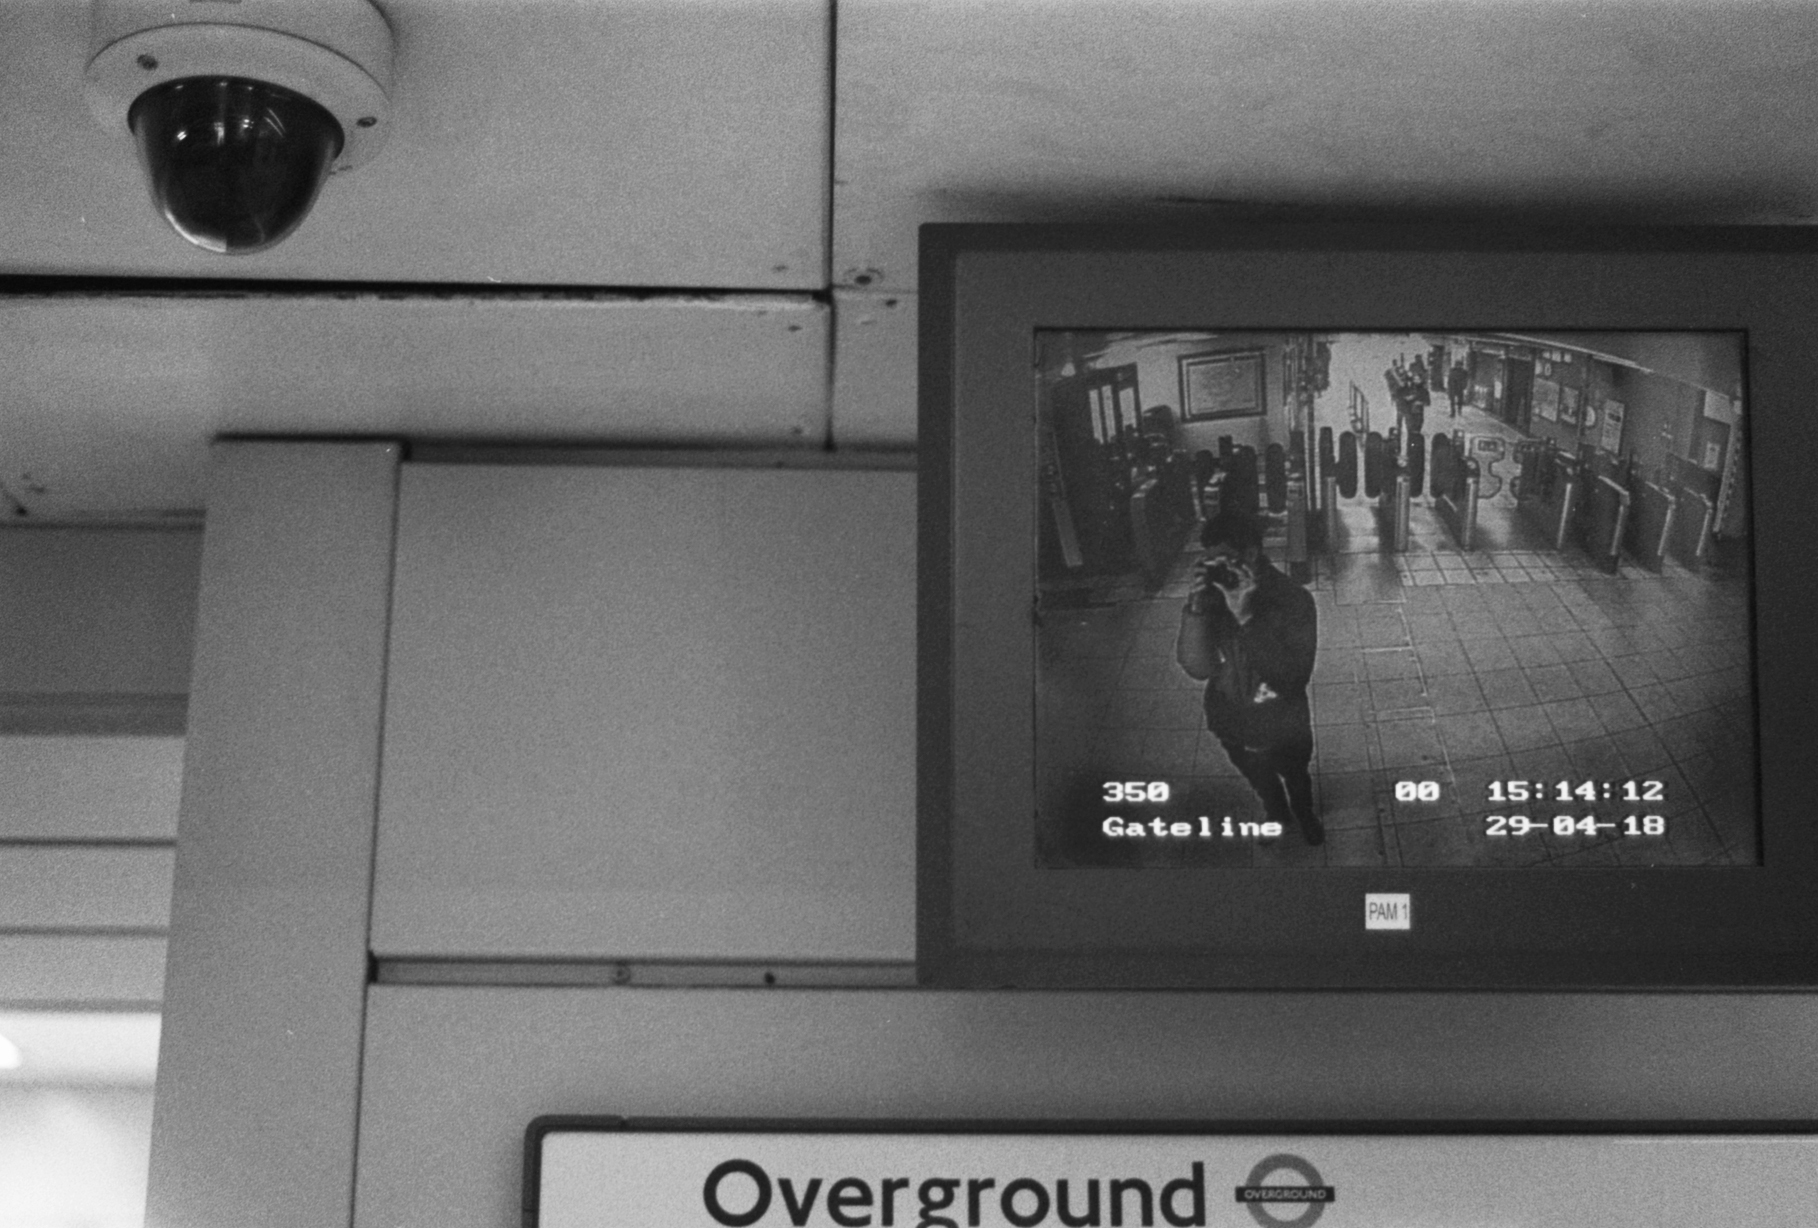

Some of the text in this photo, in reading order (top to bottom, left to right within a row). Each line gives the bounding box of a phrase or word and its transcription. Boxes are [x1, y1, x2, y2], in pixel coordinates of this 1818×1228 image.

[1102, 781, 1170, 802] 350
[1394, 781, 1440, 802] 00
[1486, 780, 1665, 802] 15:14:12
[1102, 816, 1282, 837] Gateline
[1485, 815, 1666, 836] 29-04-18
[1369, 902, 1408, 920] PAM 1
[702, 1158, 1207, 1228] Overground
[1244, 1189, 1326, 1200] OVERGROUND
